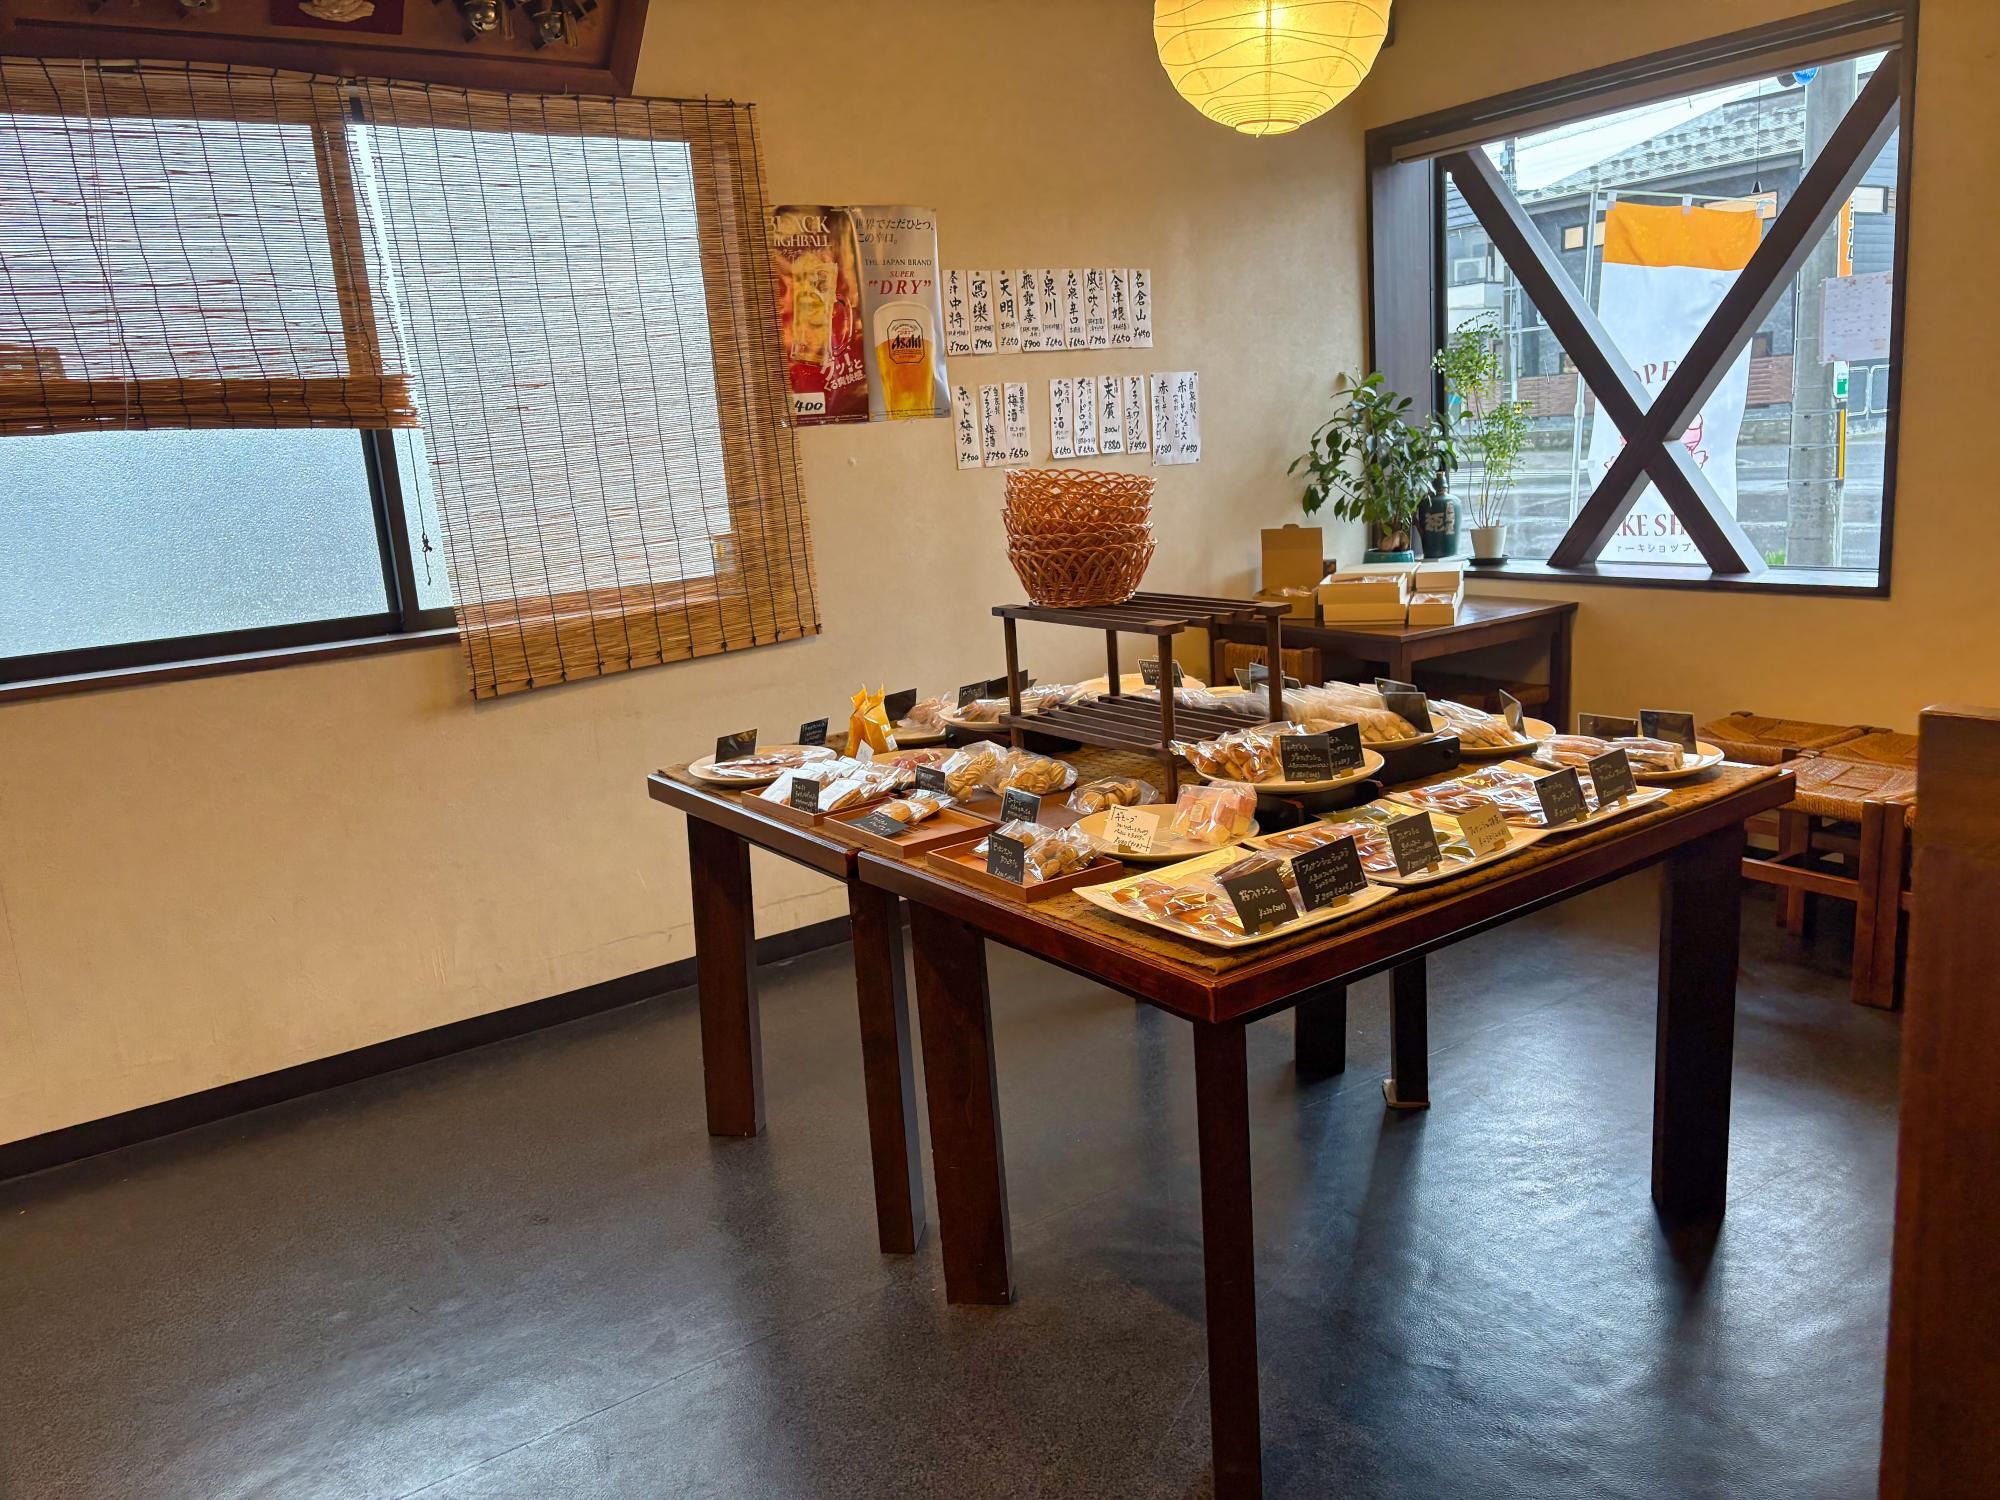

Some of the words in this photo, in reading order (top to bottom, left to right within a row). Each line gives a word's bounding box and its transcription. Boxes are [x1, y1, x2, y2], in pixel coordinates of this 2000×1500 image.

[889, 270, 915, 278] SUPER
[999, 278, 1014, 319] 天明
[1044, 275, 1057, 318] 泉川
[1134, 270, 1147, 321] 名倉山
[892, 334, 922, 350] Asahi
[795, 400, 823, 412] 400
[1617, 514, 1649, 537] KE
